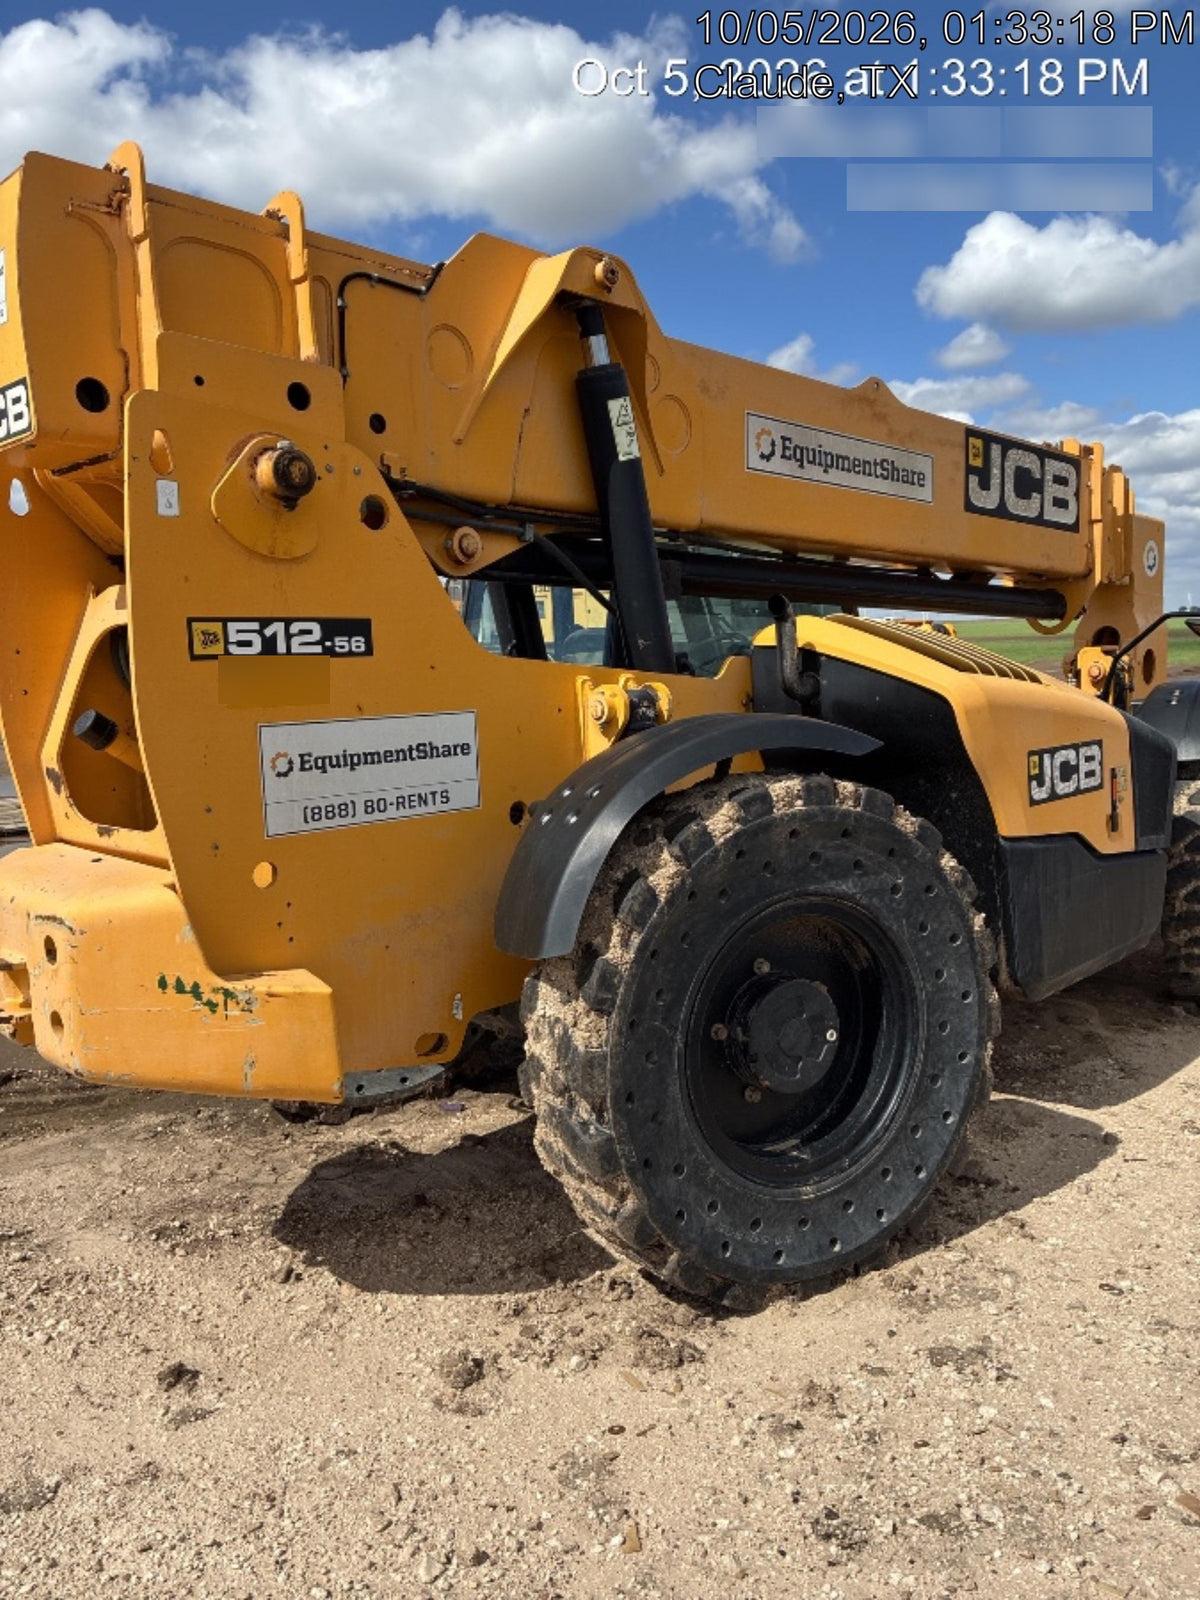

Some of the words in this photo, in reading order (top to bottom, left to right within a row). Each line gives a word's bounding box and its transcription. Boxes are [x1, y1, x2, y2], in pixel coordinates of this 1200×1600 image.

[779, 434, 926, 488] EquipmentShare
[968, 442, 1077, 526] JCB
[227, 621, 366, 655] 512-56
[298, 742, 471, 773] EquipmentShare
[1030, 743, 1102, 801] JCB
[302, 799, 357, 825] (888)
[363, 789, 450, 814] 80-RENTS
